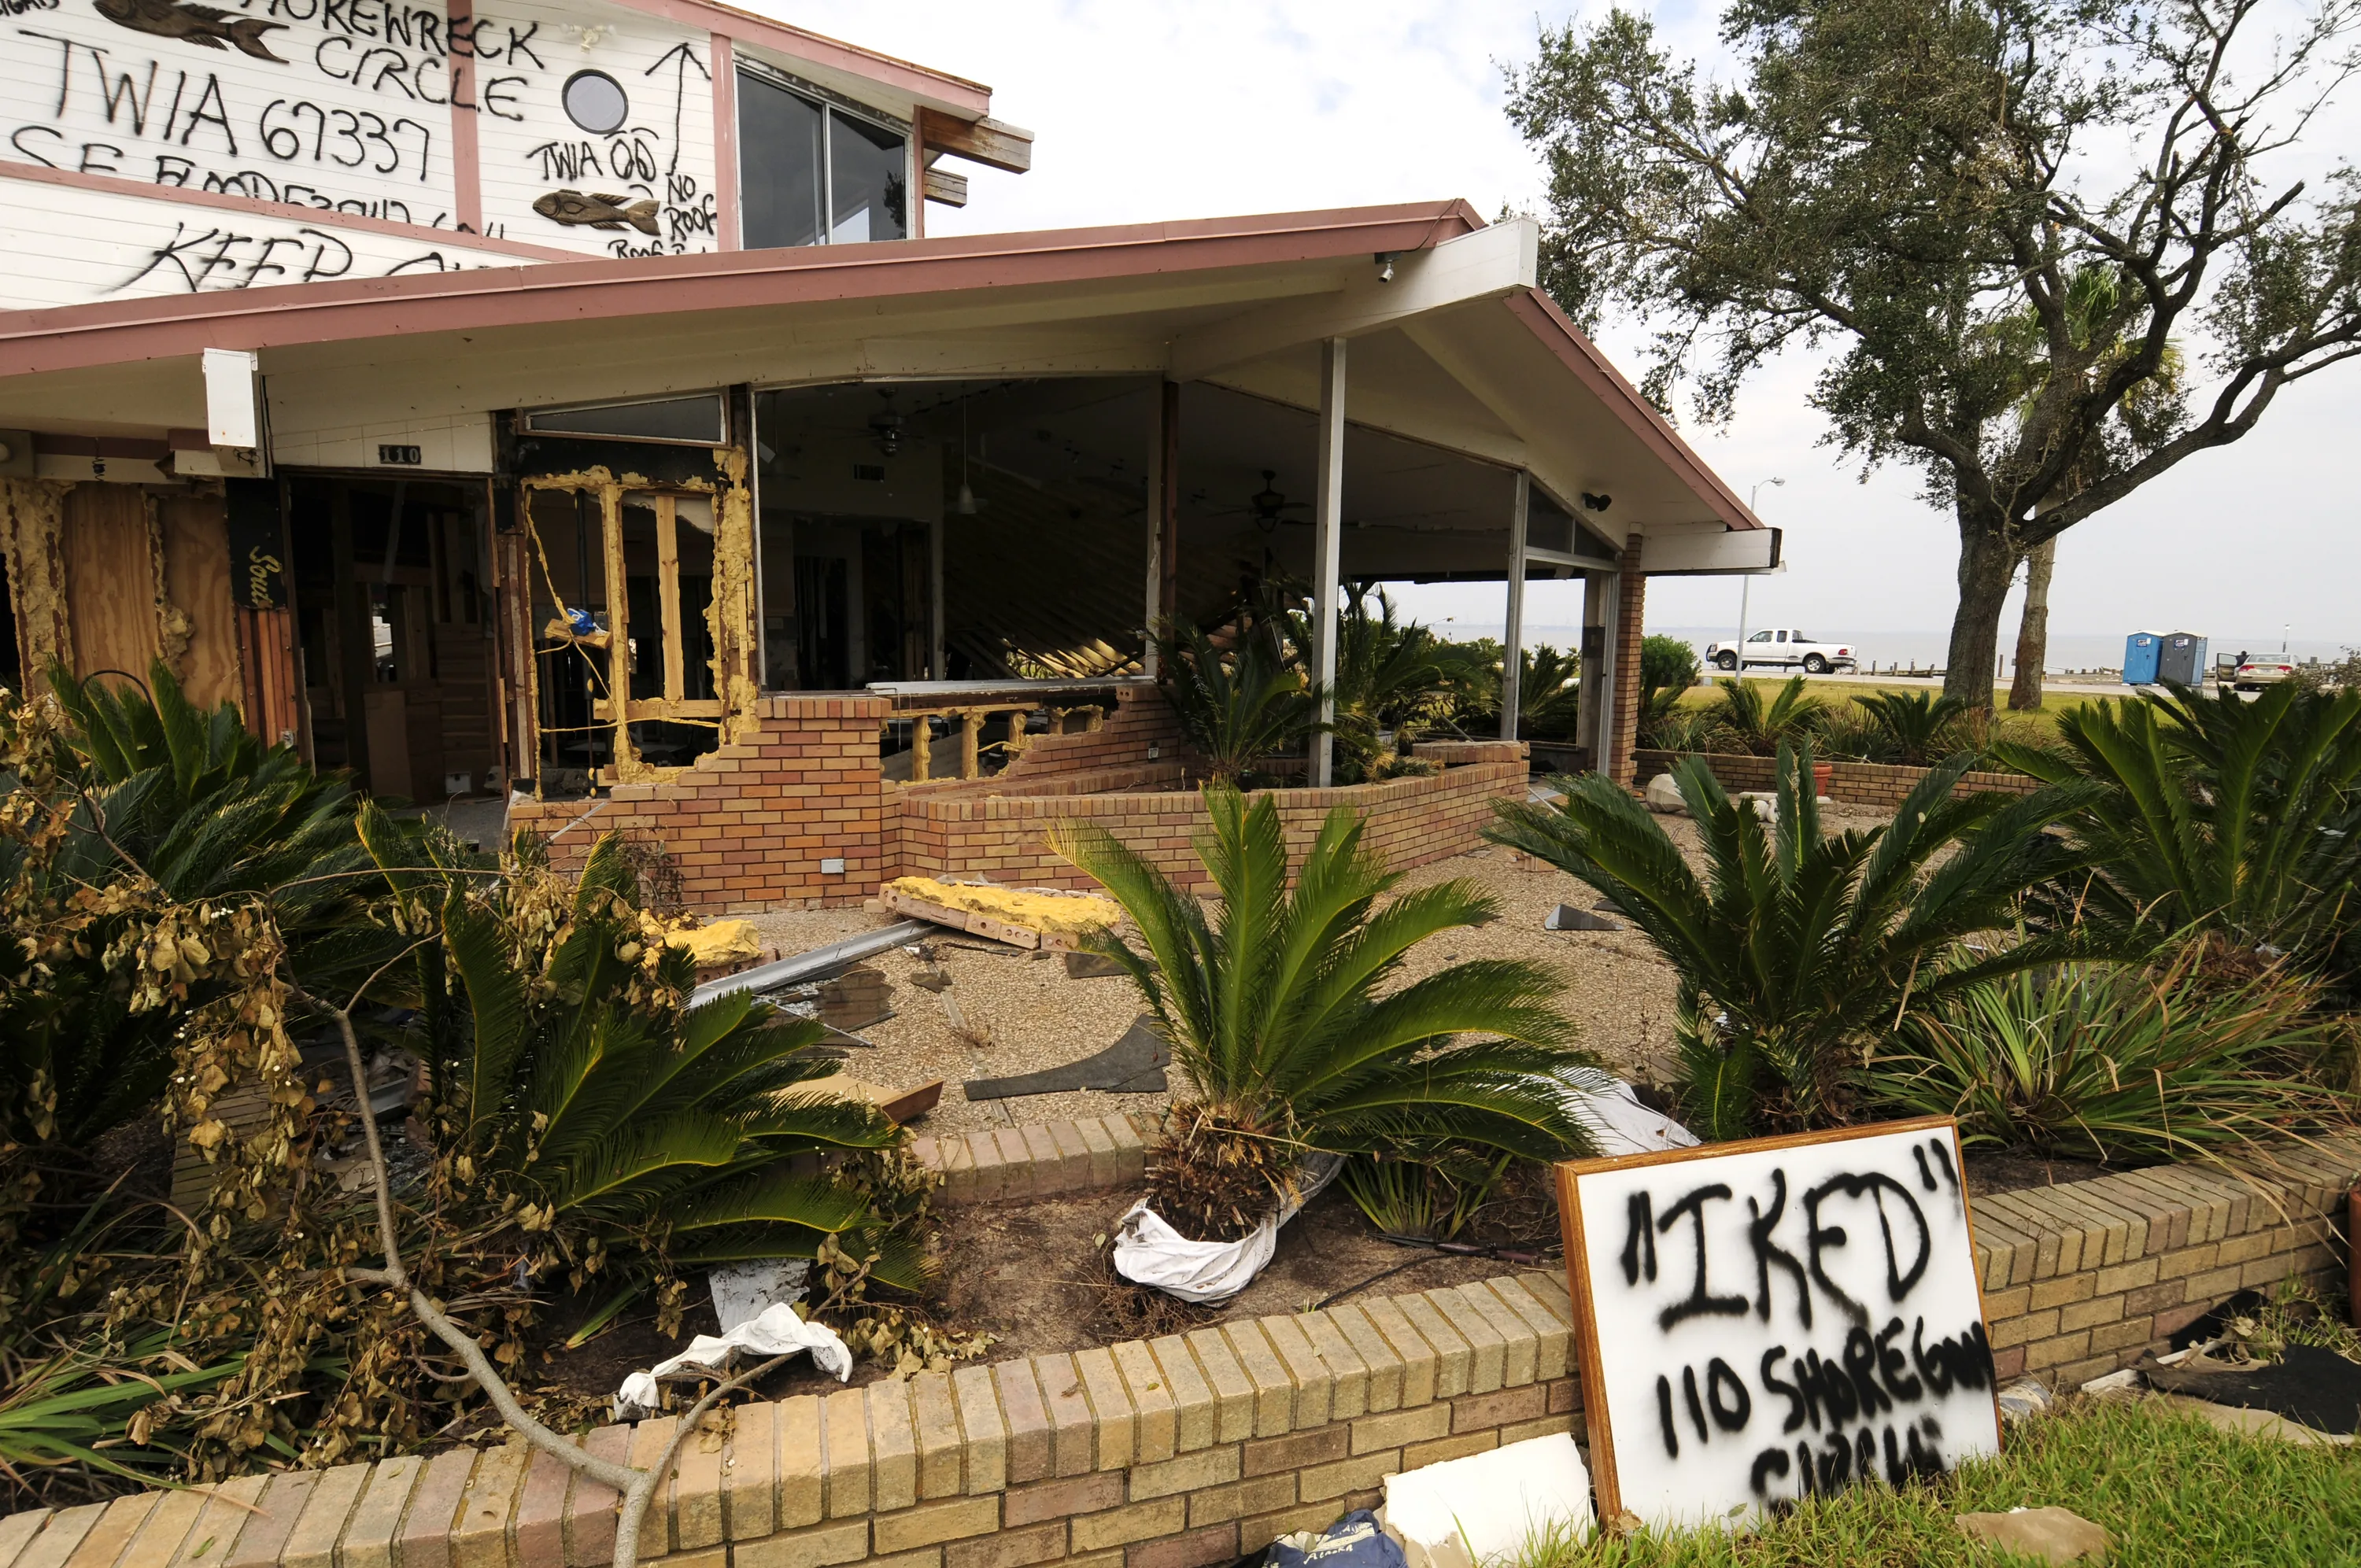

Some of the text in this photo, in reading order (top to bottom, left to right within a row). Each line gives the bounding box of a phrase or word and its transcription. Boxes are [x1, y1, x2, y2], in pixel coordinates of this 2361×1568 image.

[316, 36, 528, 122] CIRCLE
[18, 30, 430, 181] TWIA 67337
[526, 142, 603, 181] TWIA
[668, 174, 696, 205] NO
[663, 194, 717, 242] ROOF
[382, 446, 419, 463] 110
[1656, 1356, 1751, 1460] 110
